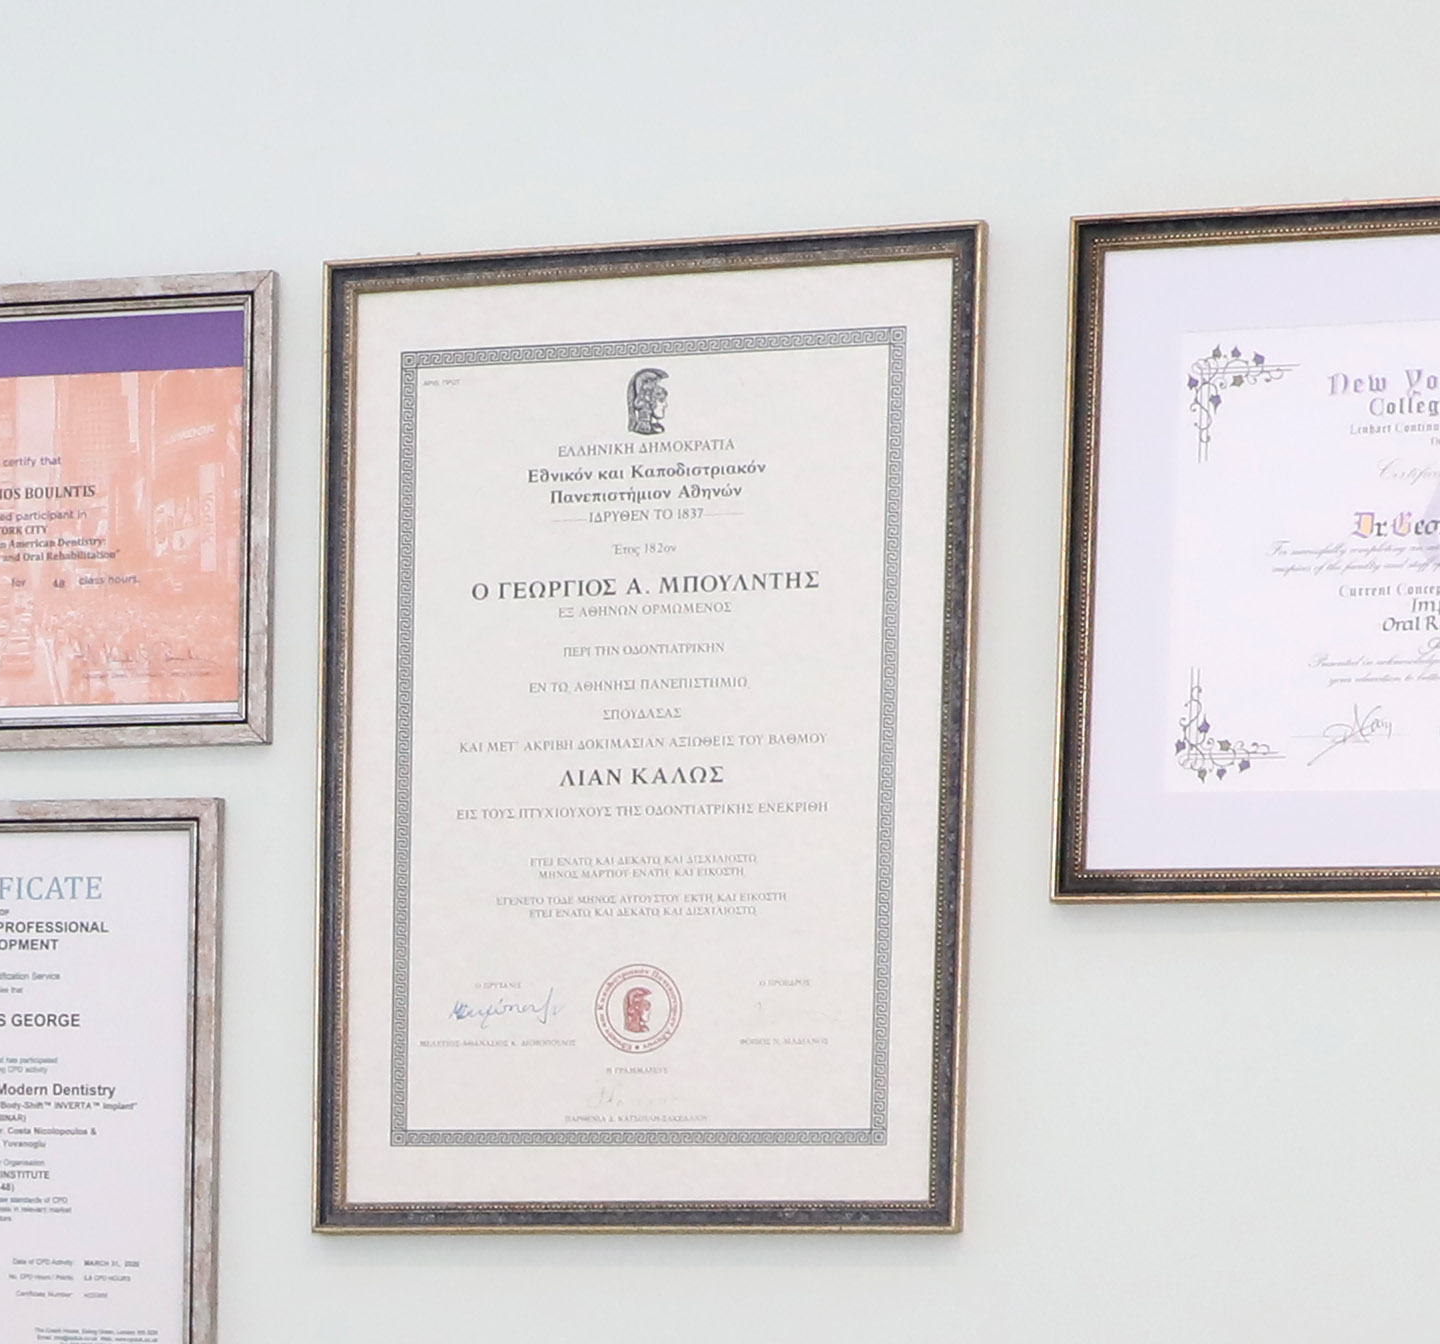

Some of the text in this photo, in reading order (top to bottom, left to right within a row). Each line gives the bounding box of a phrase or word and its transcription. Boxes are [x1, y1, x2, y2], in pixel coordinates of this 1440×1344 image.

[1327, 372, 1388, 395] New
[558, 439, 735, 458] ΕΛΛΗΝΙΚΗ ΔΗΜΟΚΡΑΤΙΑ
[3, 457, 36, 467] certify
[40, 456, 61, 465] that
[598, 468, 623, 480] και
[631, 460, 766, 479] Καποδιστριακόν
[25, 485, 95, 500] BOULNTIS
[550, 483, 742, 504] Πανεπιστήμιον Αθηνών
[589, 508, 704, 523] ΙΔΡΥΘΕΝ ΤΟ 1837
[25, 525, 47, 534] CITY
[9, 539, 55, 549] American
[10, 577, 26, 587] for
[79, 576, 105, 585] class
[499, 579, 616, 599] ΓΕΩΡΓΙΟΣ
[626, 578, 650, 595] Α.
[659, 571, 820, 594] ΜΠΟΥΛΝΤΗΣ
[579, 605, 638, 617] ΑΘΗΝΩΝ
[1382, 617, 1420, 632] Oral
[559, 766, 724, 787] ΛΙΑΝ ΚΑΛΩΣ
[456, 809, 478, 820] ΕΙΣ
[482, 808, 514, 820] ΤΟΥΣ
[617, 806, 642, 817] ΤΗΣ
[11, 1013, 80, 1027] GEORGE
[53, 1083, 116, 1098] Dentistry
[0, 1170, 49, 1180] INSTITUTE
